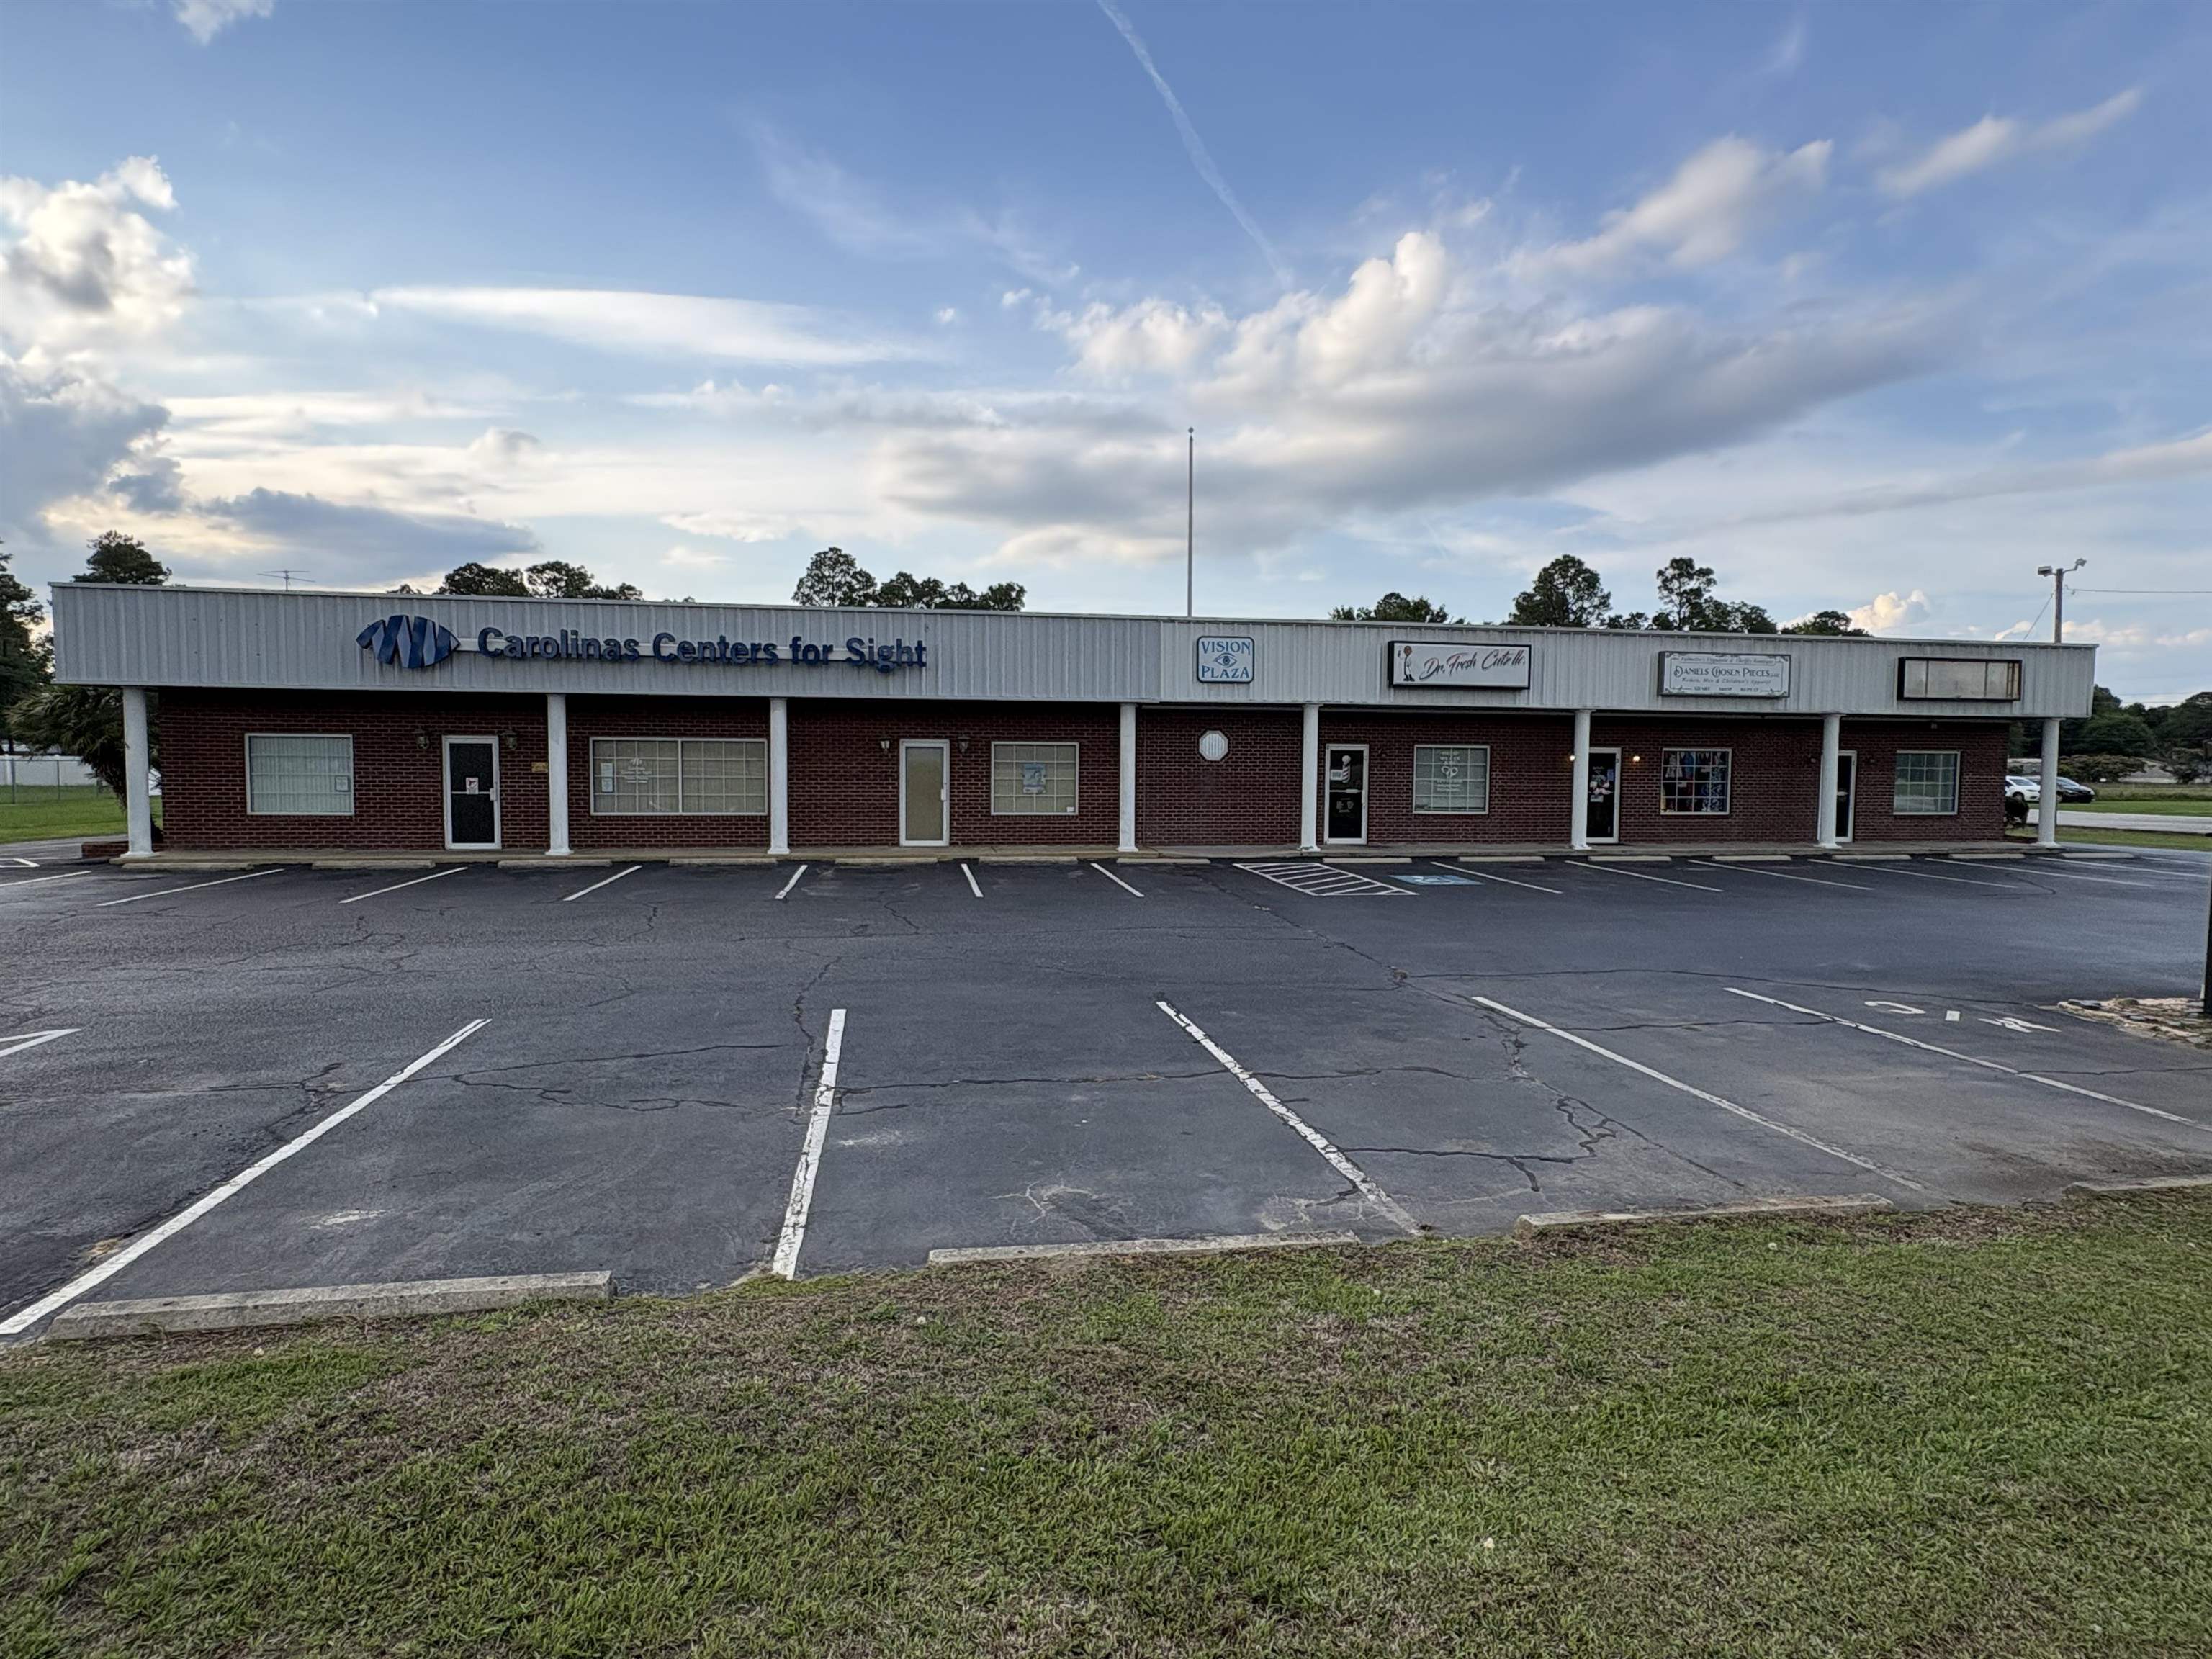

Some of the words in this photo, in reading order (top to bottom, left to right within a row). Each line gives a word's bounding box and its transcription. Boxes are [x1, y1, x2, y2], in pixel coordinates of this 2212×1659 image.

[478, 626, 640, 660] Carolinas
[652, 632, 779, 665] Centers
[789, 636, 834, 665] for
[845, 637, 927, 673] Sight
[1201, 641, 1251, 655] VISION
[1201, 665, 1250, 678] PLAZA
[1419, 657, 1445, 680] Dr.
[1446, 652, 1478, 676] Fresh
[1743, 667, 1770, 678] PIECES
